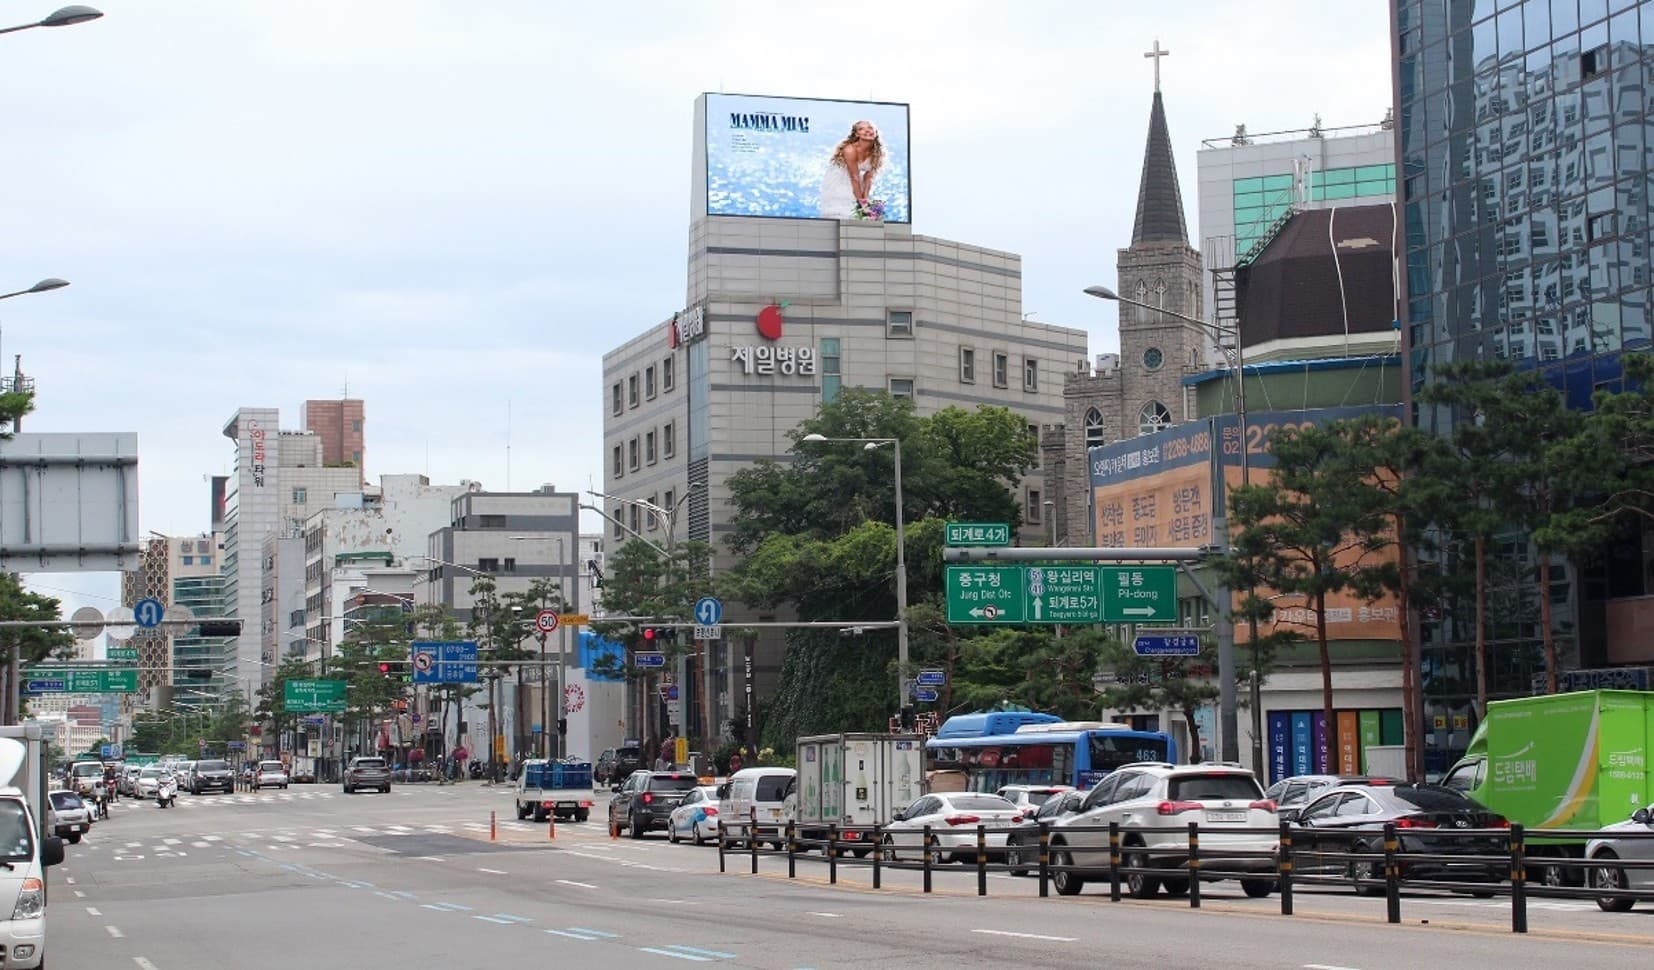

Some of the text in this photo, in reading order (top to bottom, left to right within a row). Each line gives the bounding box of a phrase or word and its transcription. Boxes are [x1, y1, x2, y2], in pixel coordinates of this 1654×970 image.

[730, 112, 809, 133] MAMMA MIA!
[732, 346, 817, 375] 제일병원
[951, 527, 1006, 541] 퇴계로4가
[959, 572, 1001, 588] 중구청
[1047, 569, 1094, 584] 왕십리역
[1118, 572, 1144, 586] 필동
[1118, 588, 1158, 600] Pil-dong
[1049, 596, 1098, 609] 퇴계로5가
[541, 616, 554, 627] 50
[1136, 750, 1157, 761] 463
[1608, 754, 1644, 767] 드림택배
[1495, 759, 1537, 784] 드림택배
